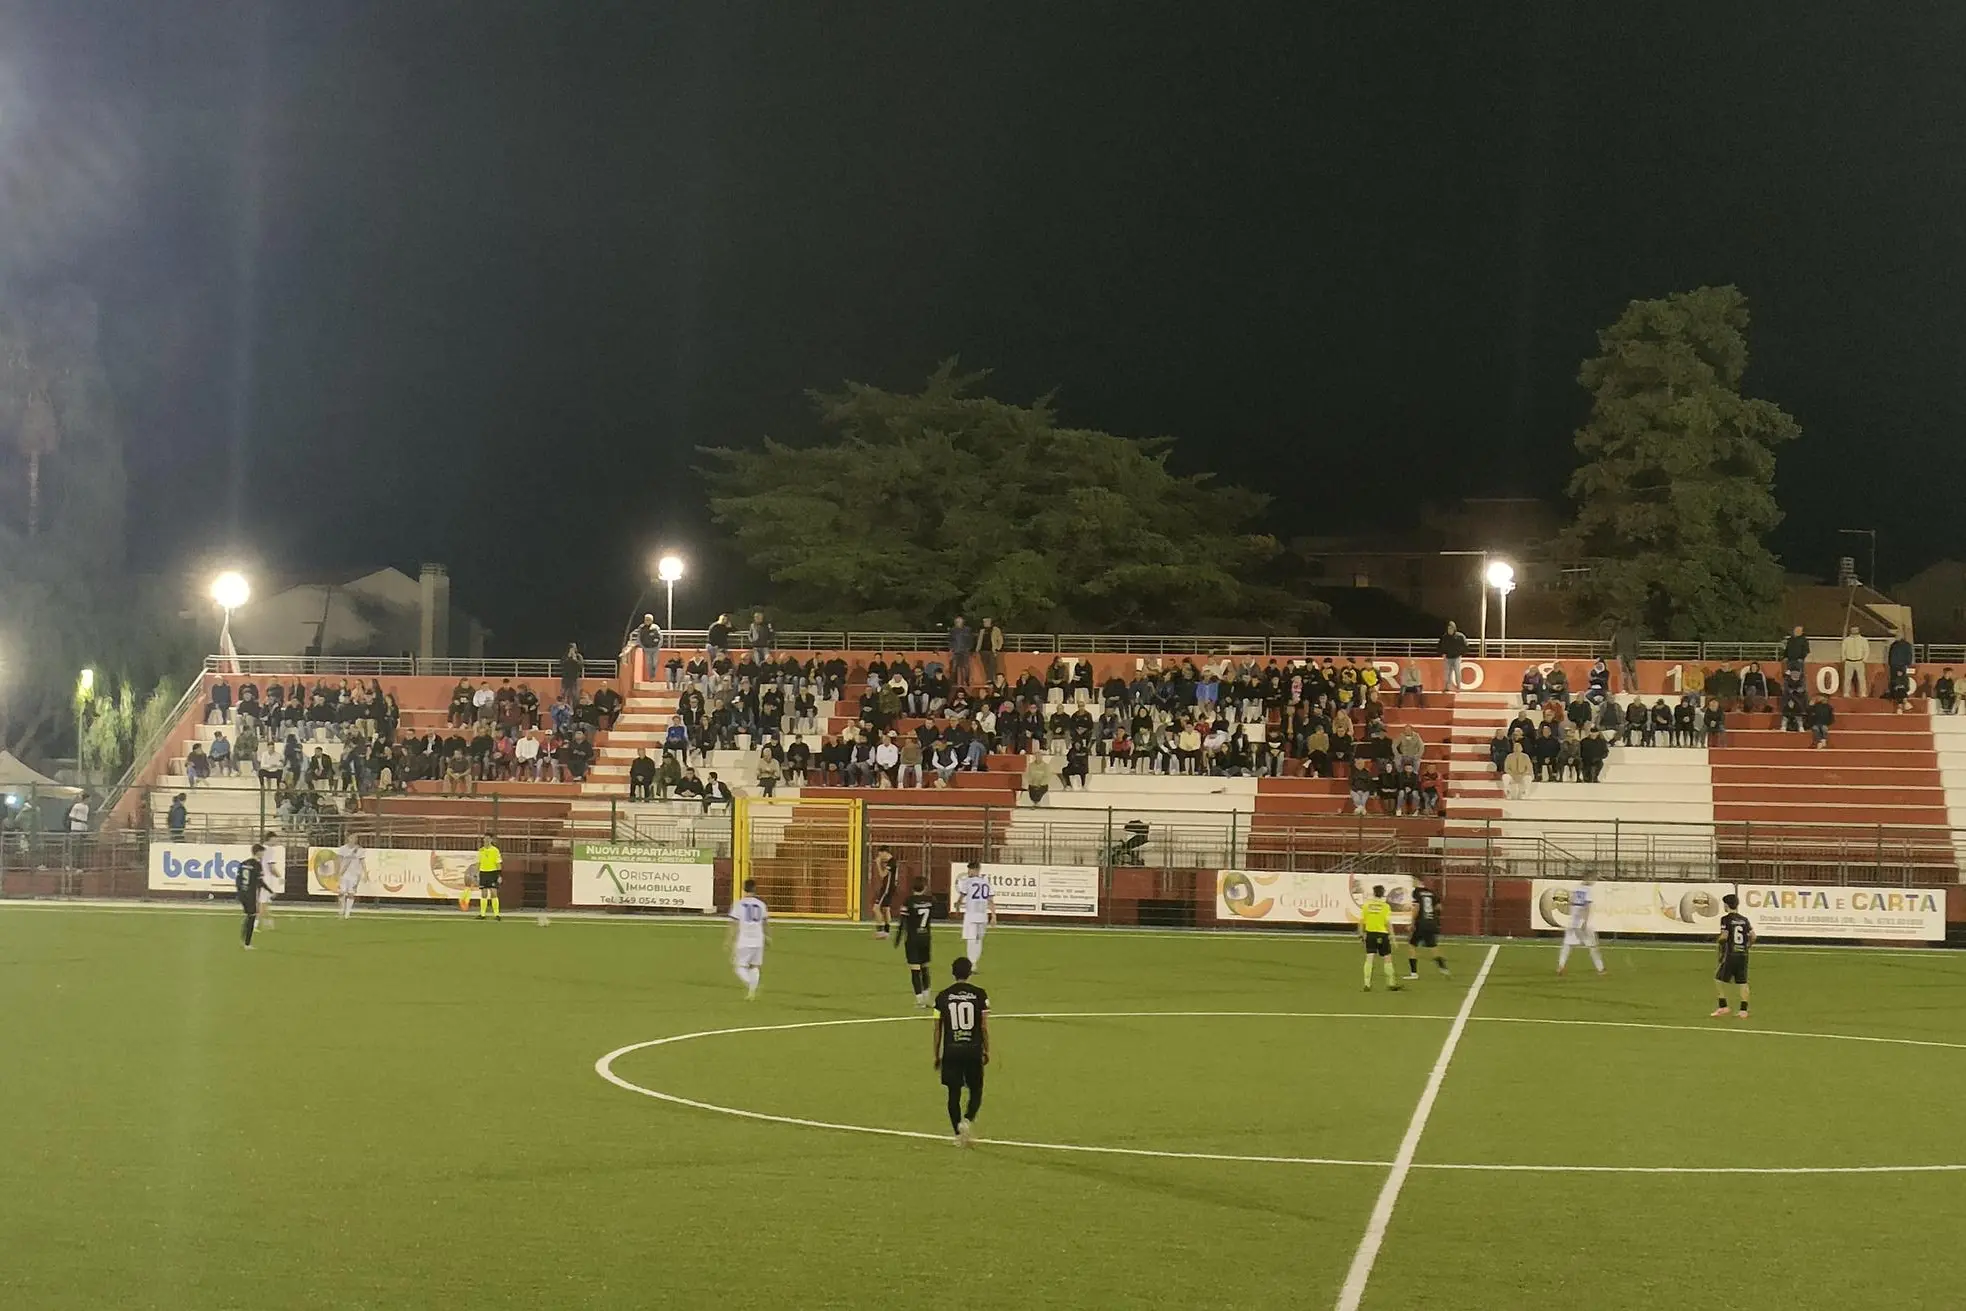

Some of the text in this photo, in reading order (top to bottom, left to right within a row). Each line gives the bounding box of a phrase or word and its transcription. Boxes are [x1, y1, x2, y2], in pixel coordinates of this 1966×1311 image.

[586, 845, 700, 857] NUOVI APPARTAMENTI
[619, 869, 680, 881] ORISTANO
[626, 882, 692, 893] IMMOBILIARE
[971, 883, 990, 900] 20
[619, 896, 636, 904] 349
[639, 897, 656, 905] 054
[1745, 889, 1938, 913] CARTA E CARTA
[742, 903, 763, 922] 10
[917, 908, 930, 928] 7
[1733, 925, 1744, 945] 6
[948, 1001, 975, 1030] 10
